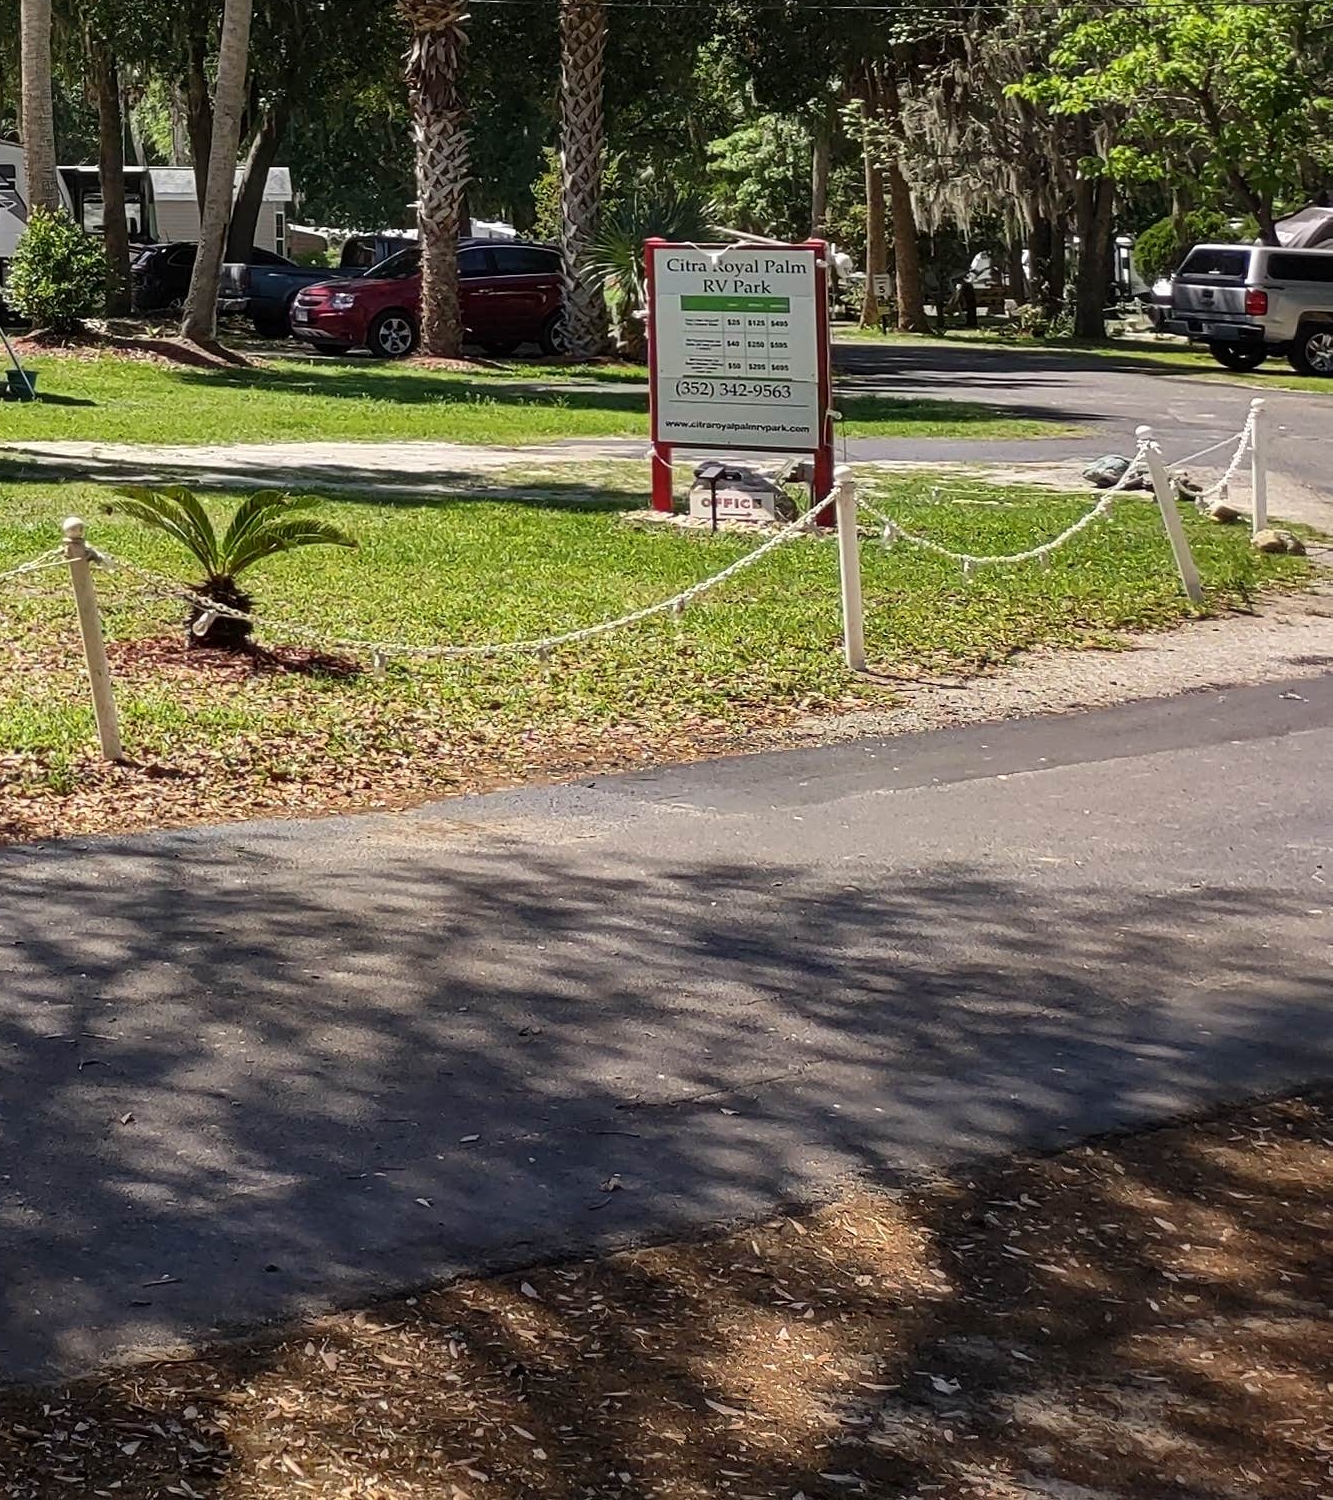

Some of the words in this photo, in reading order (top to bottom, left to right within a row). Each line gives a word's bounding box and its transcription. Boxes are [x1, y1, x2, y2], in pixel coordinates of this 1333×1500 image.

[666, 258, 707, 272] Citra
[713, 259, 759, 277] Royal
[764, 259, 807, 274] Palm
[703, 279, 728, 293] RV
[734, 279, 772, 294] Park
[675, 380, 715, 399] (352)
[719, 382, 792, 399] 342-9563
[665, 419, 810, 434] www.citraroyalpalmrvpark.com
